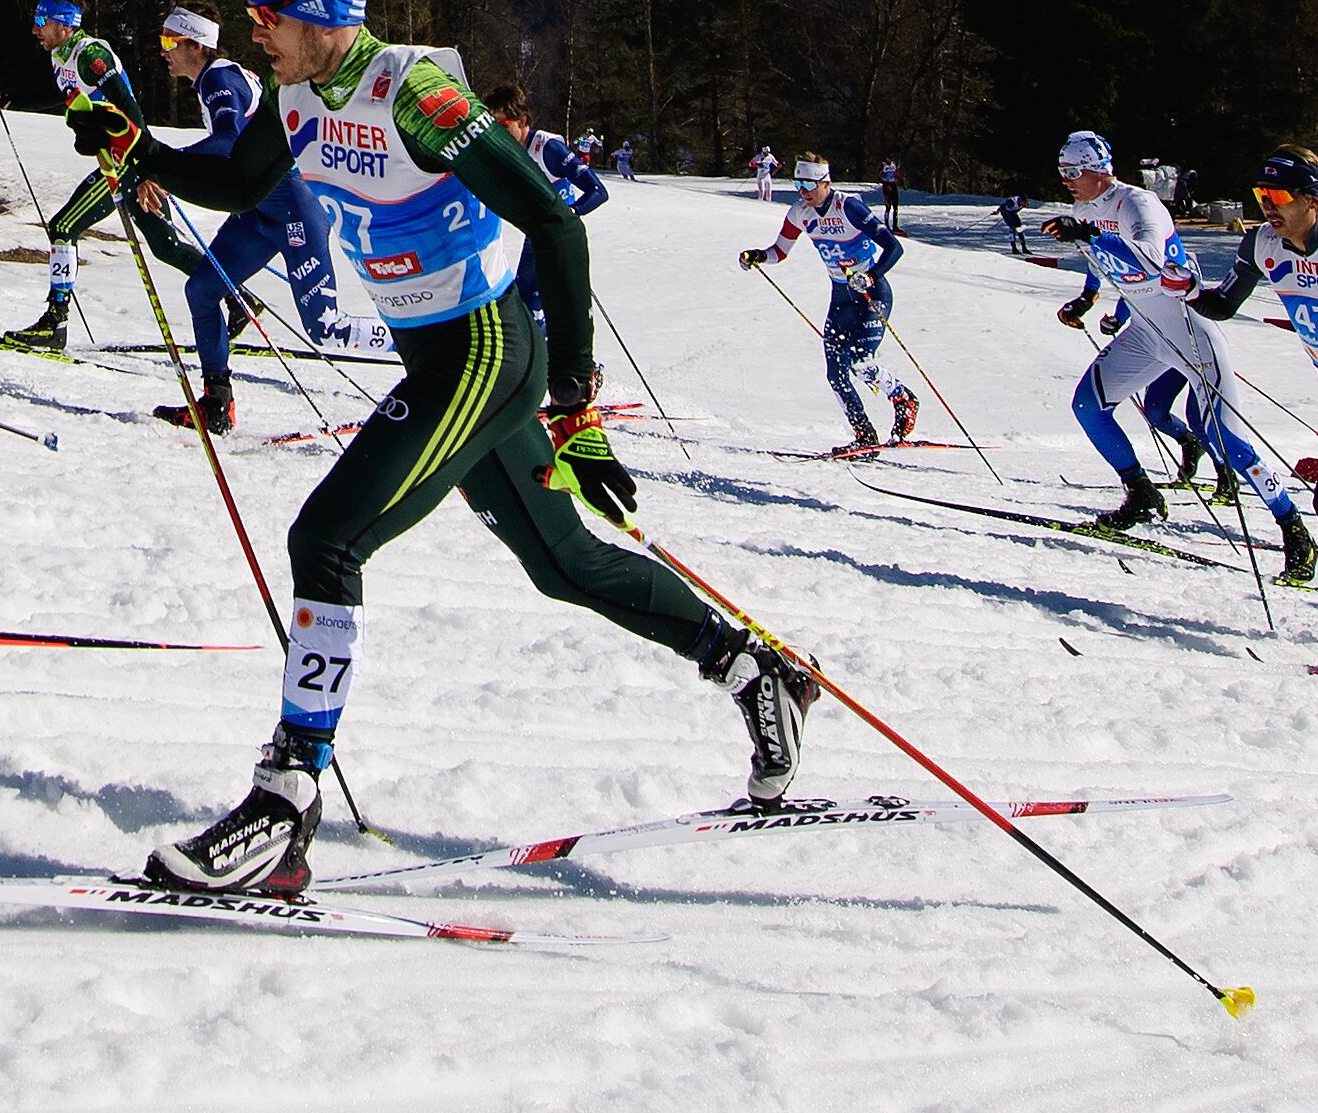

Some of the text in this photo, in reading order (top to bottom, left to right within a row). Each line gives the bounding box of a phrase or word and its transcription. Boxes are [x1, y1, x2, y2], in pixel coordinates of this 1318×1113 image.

[297, 5, 330, 20] adidas
[205, 89, 233, 106] USANA
[322, 116, 388, 152] INTER
[321, 143, 389, 179] SPORT
[287, 222, 303, 232] US
[318, 195, 374, 255] 27
[818, 217, 843, 229] INTER
[820, 225, 845, 235] SPORT
[1096, 219, 1119, 232] INTER
[52, 262, 71, 277] 24
[291, 256, 321, 281] VISA
[370, 257, 414, 277] Tirol
[1096, 250, 1130, 276] 30
[308, 273, 331, 297] TOYOTA
[862, 320, 883, 329] VISA
[369, 325, 387, 348] 35
[575, 411, 598, 427] EKI
[297, 652, 352, 693] 27
[757, 692, 769, 737] SUPER
[761, 674, 791, 765] NANO
[729, 810, 920, 833] MADSHUS
[208, 815, 270, 858] MADSHUS
[106, 890, 326, 922] MADSHUS
